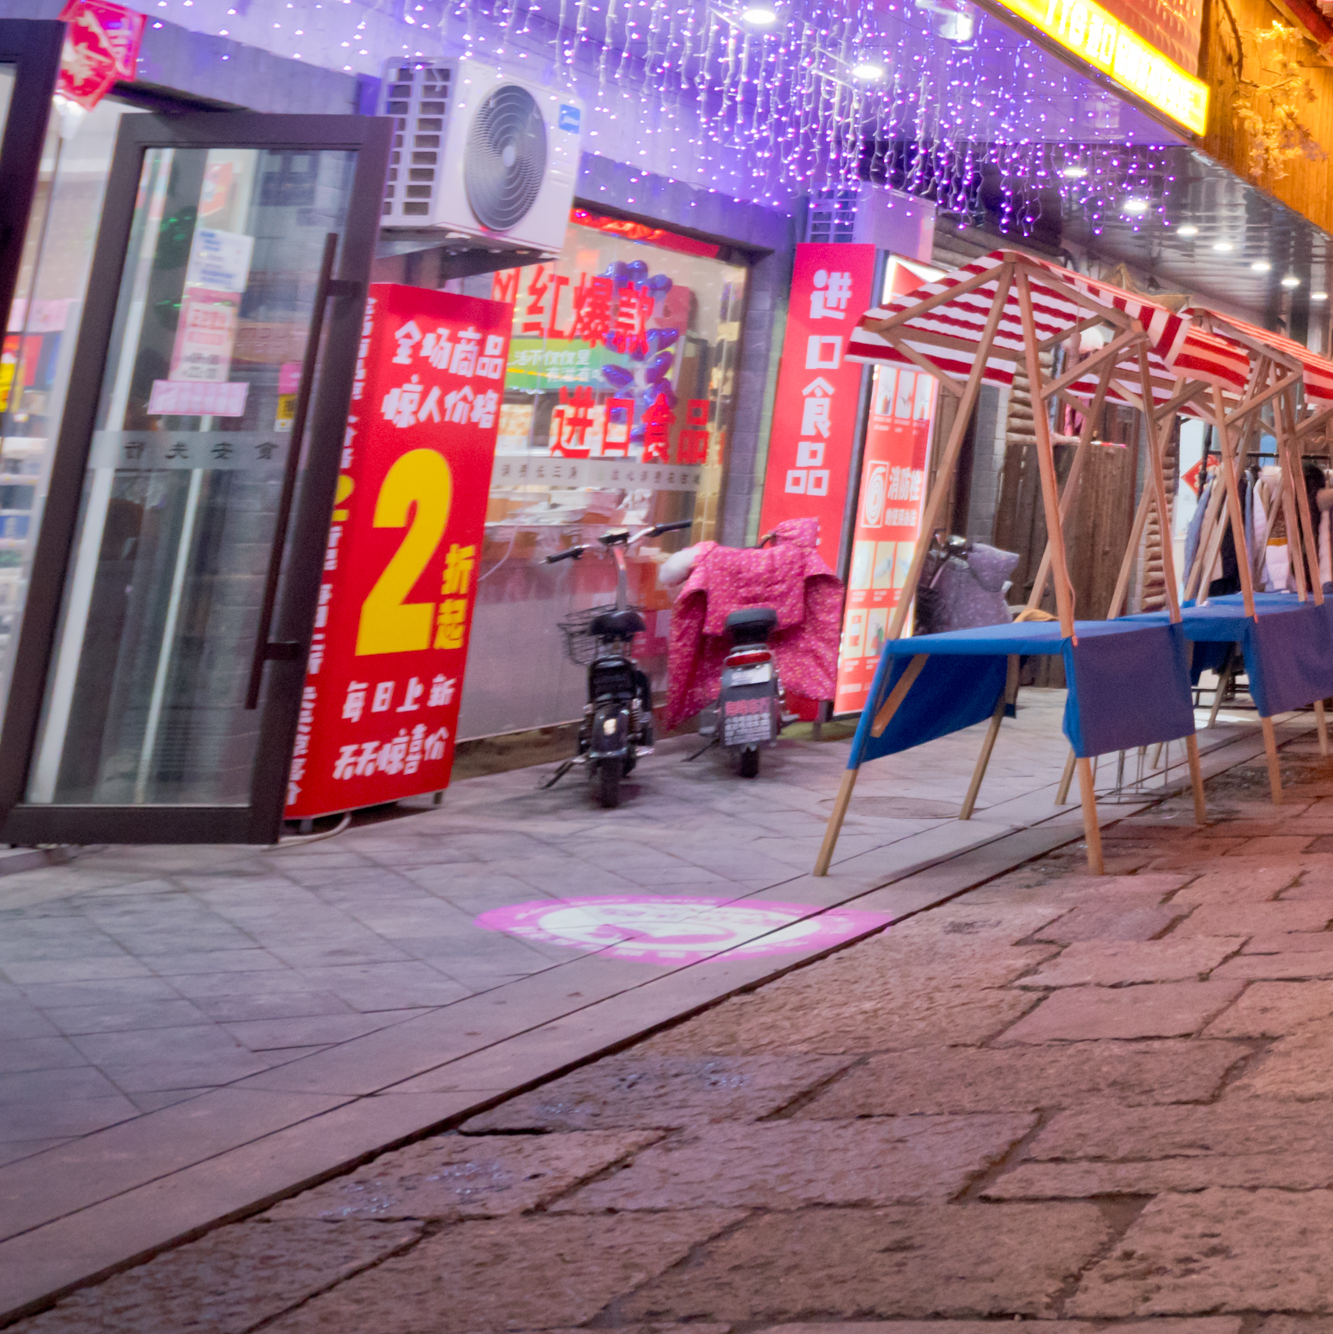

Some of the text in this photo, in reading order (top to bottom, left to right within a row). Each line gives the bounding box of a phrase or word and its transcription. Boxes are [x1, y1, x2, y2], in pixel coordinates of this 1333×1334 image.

[394, 320, 504, 380] 全场商品
[381, 375, 500, 430] 惊人价格
[784, 269, 852, 497] 进口食品
[549, 384, 711, 465] 进口食品
[887, 466, 921, 501] 消防栓
[355, 448, 453, 656] 2
[432, 543, 475, 651] 折起
[341, 673, 457, 723] 每日上新
[333, 723, 450, 781] 天天惊喜价
